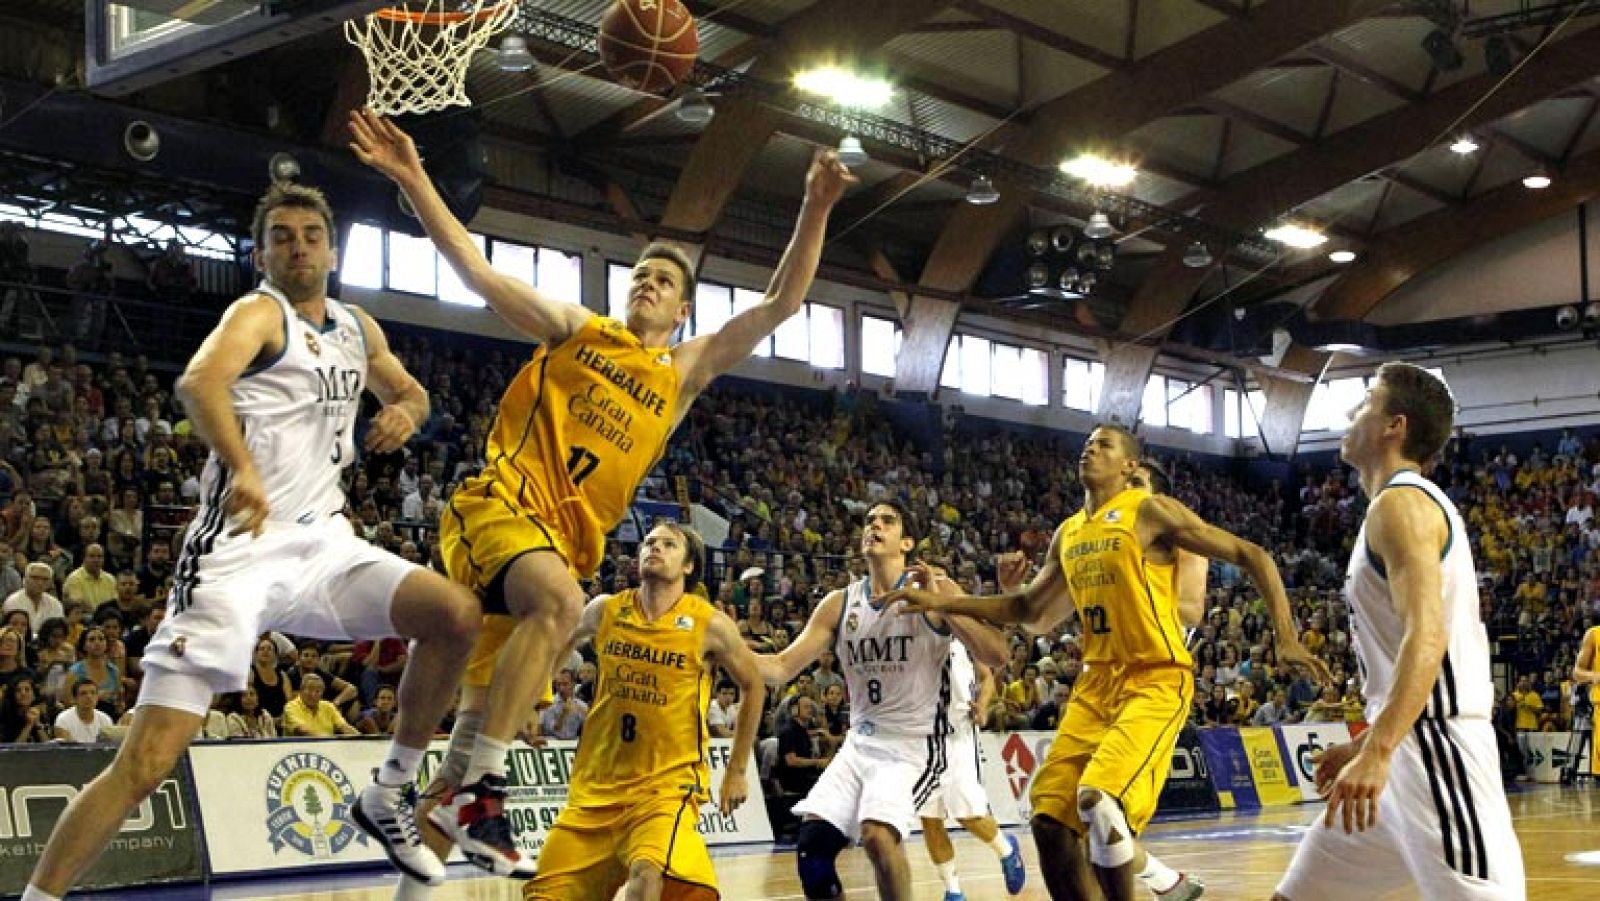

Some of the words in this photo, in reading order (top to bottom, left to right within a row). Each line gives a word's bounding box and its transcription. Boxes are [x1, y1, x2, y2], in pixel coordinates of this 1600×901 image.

[575, 344, 667, 417] HERBALIFE
[587, 383, 632, 432] Gran
[566, 445, 600, 486] 17
[603, 641, 688, 669] HERBALIFE
[845, 635, 914, 667] MMT
[616, 663, 658, 689] Gran
[868, 679, 882, 705] 8
[620, 712, 637, 743] 8
